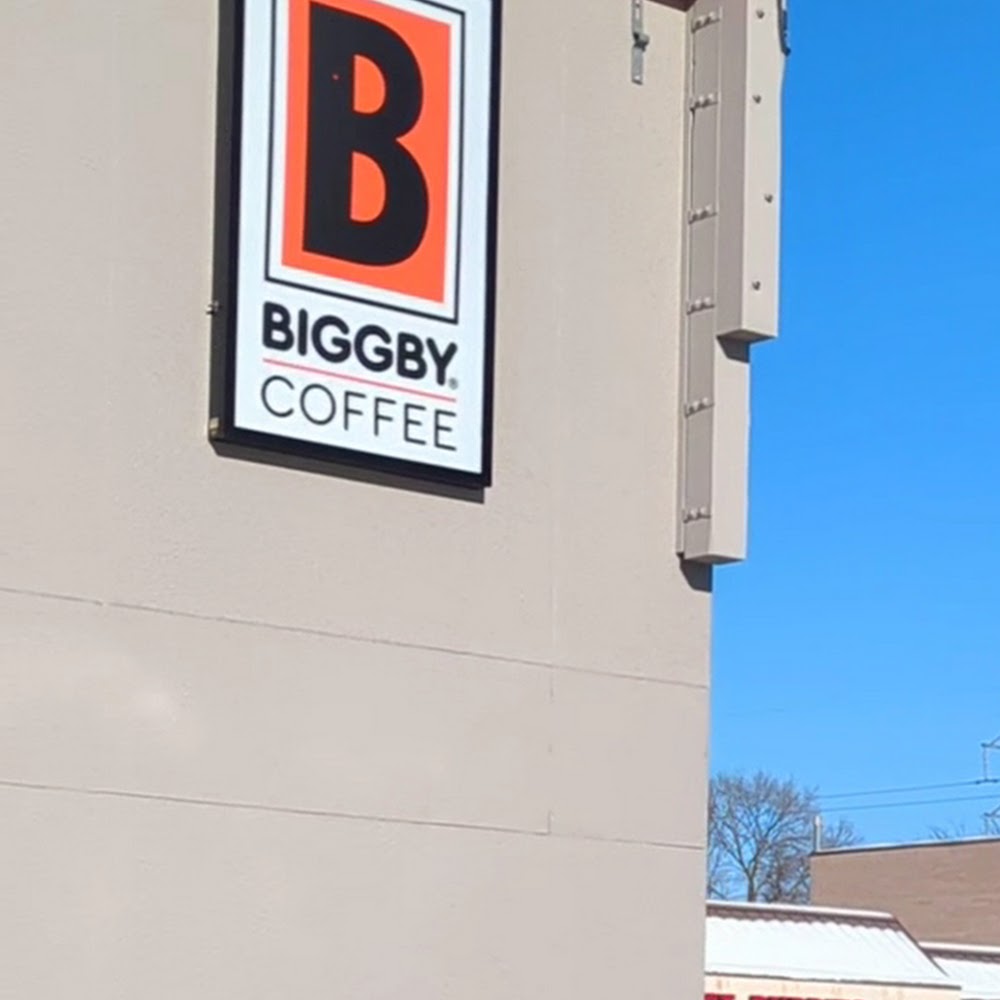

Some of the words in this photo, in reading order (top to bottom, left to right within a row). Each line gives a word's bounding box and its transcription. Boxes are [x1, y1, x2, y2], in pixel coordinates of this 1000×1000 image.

[302, 1, 430, 267] B
[262, 301, 458, 386] BIGGBY
[261, 375, 457, 451] COFFEE
